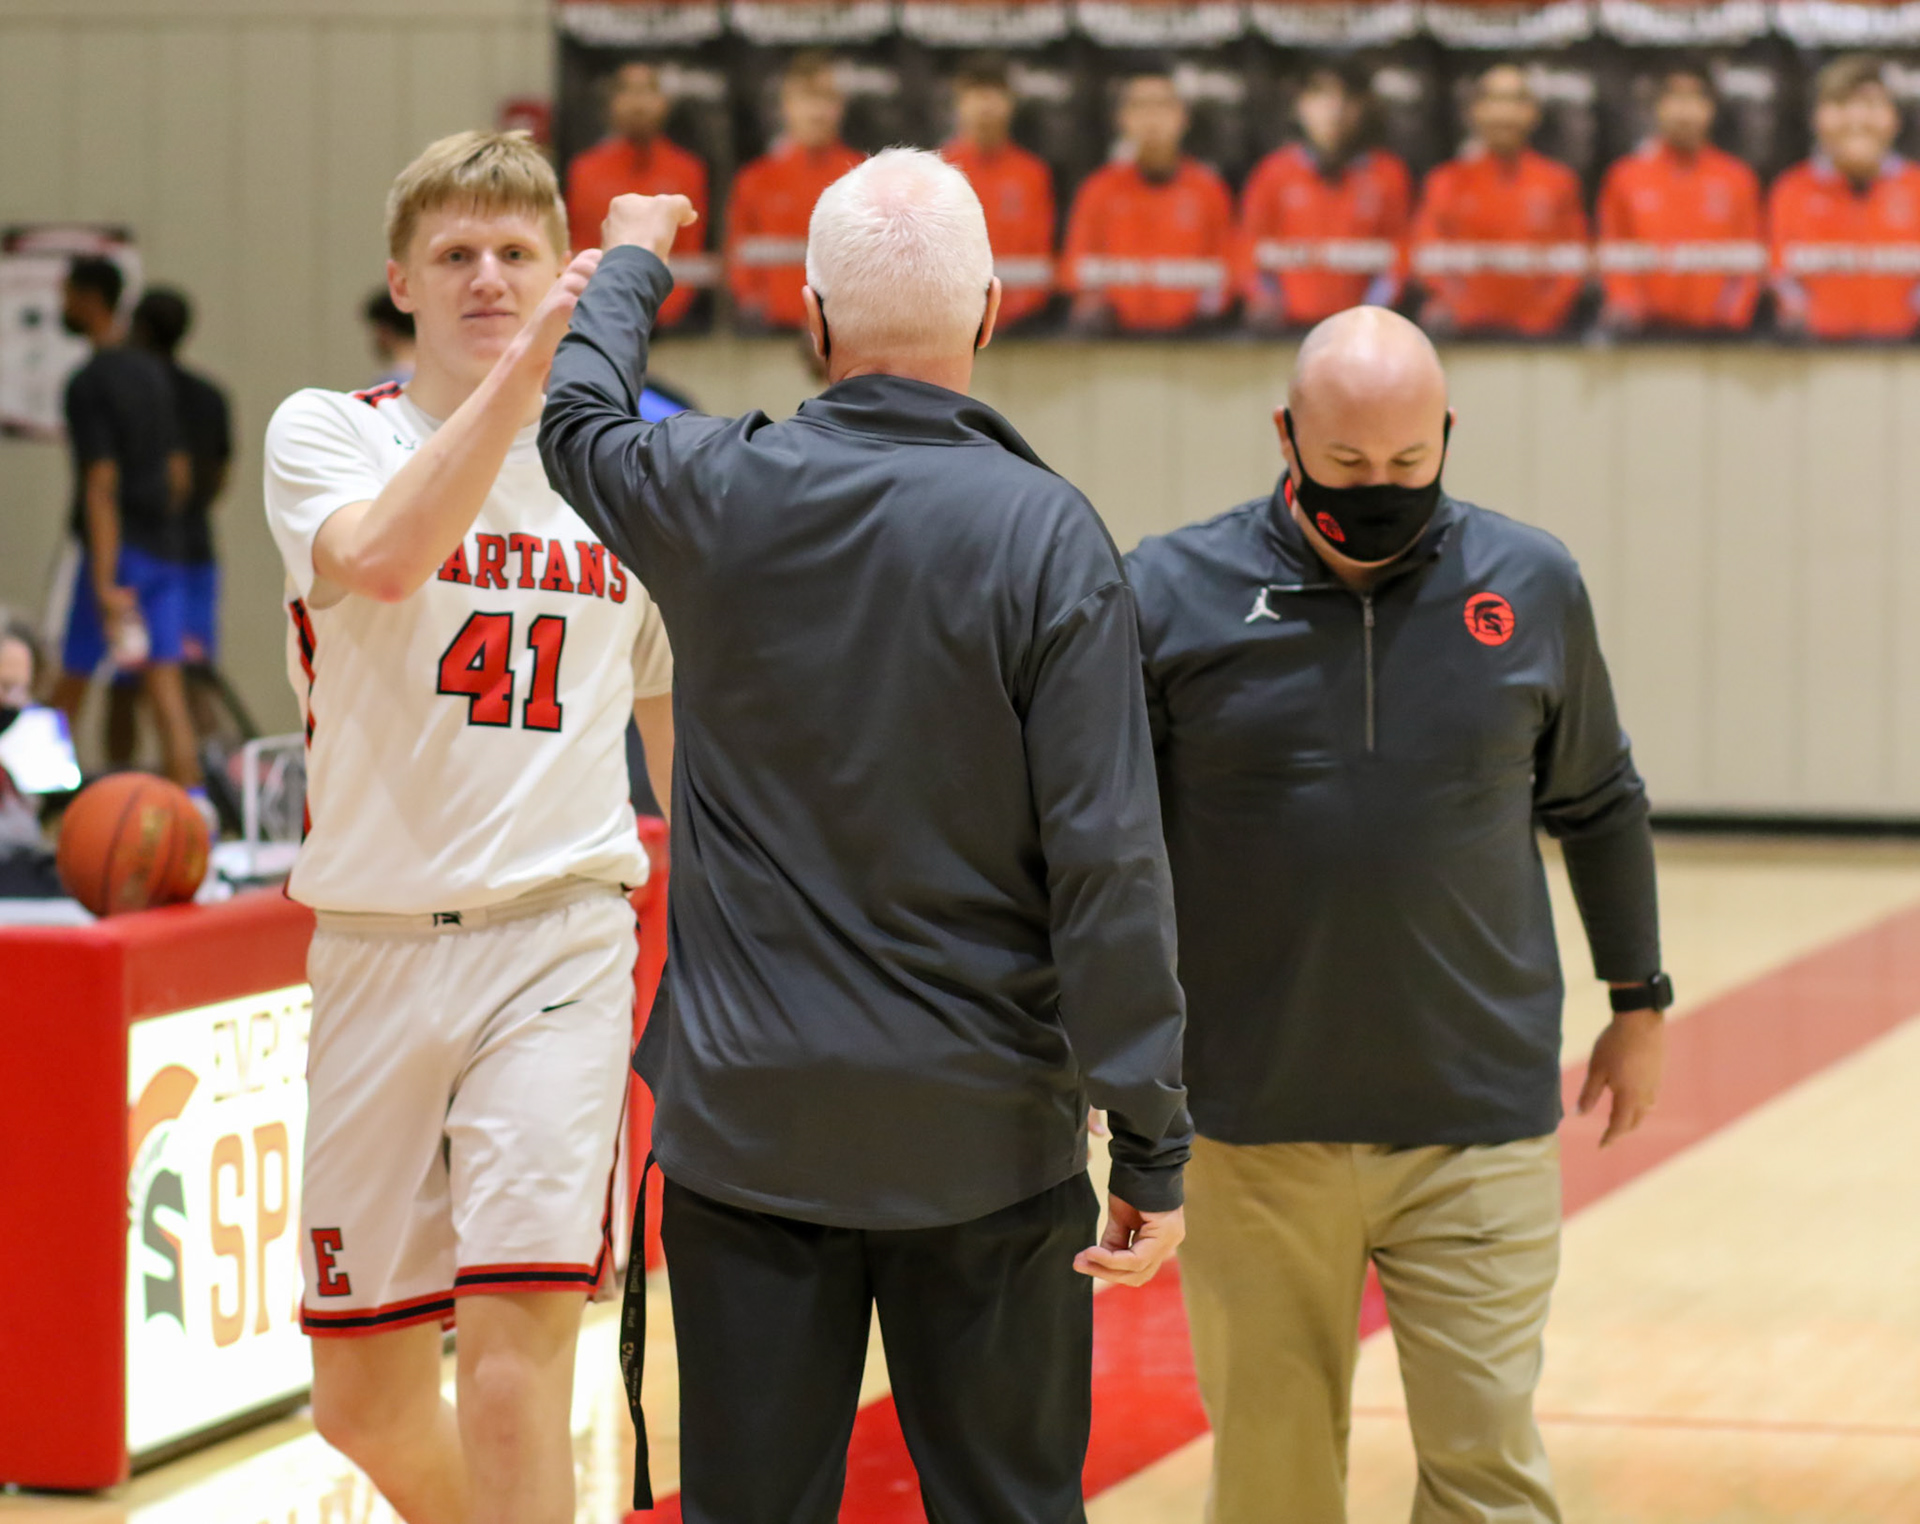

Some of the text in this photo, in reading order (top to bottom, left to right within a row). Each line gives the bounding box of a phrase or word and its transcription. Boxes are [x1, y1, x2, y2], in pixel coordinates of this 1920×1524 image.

[437, 532, 627, 604] ARTANS
[436, 610, 566, 733] 41
[210, 1120, 301, 1348] SP
[310, 1227, 352, 1297] E
